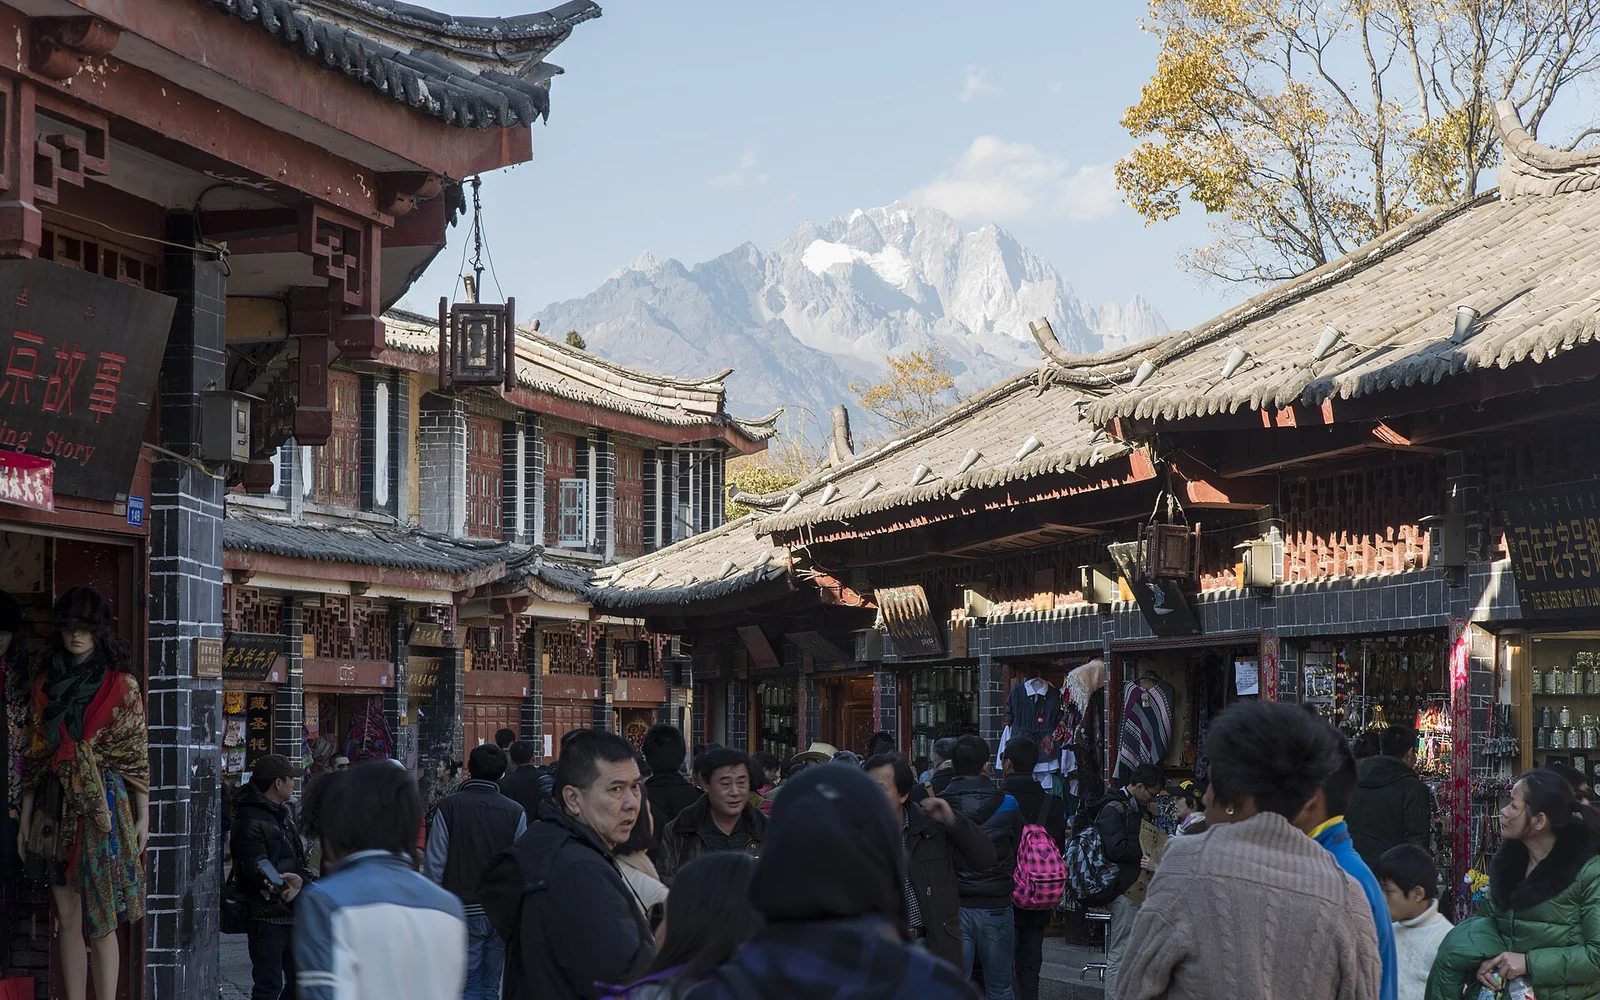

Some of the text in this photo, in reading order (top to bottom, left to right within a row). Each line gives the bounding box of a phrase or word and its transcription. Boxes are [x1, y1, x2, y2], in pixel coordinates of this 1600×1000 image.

[0, 419, 97, 466] ing Story
[130, 509, 141, 522] 149
